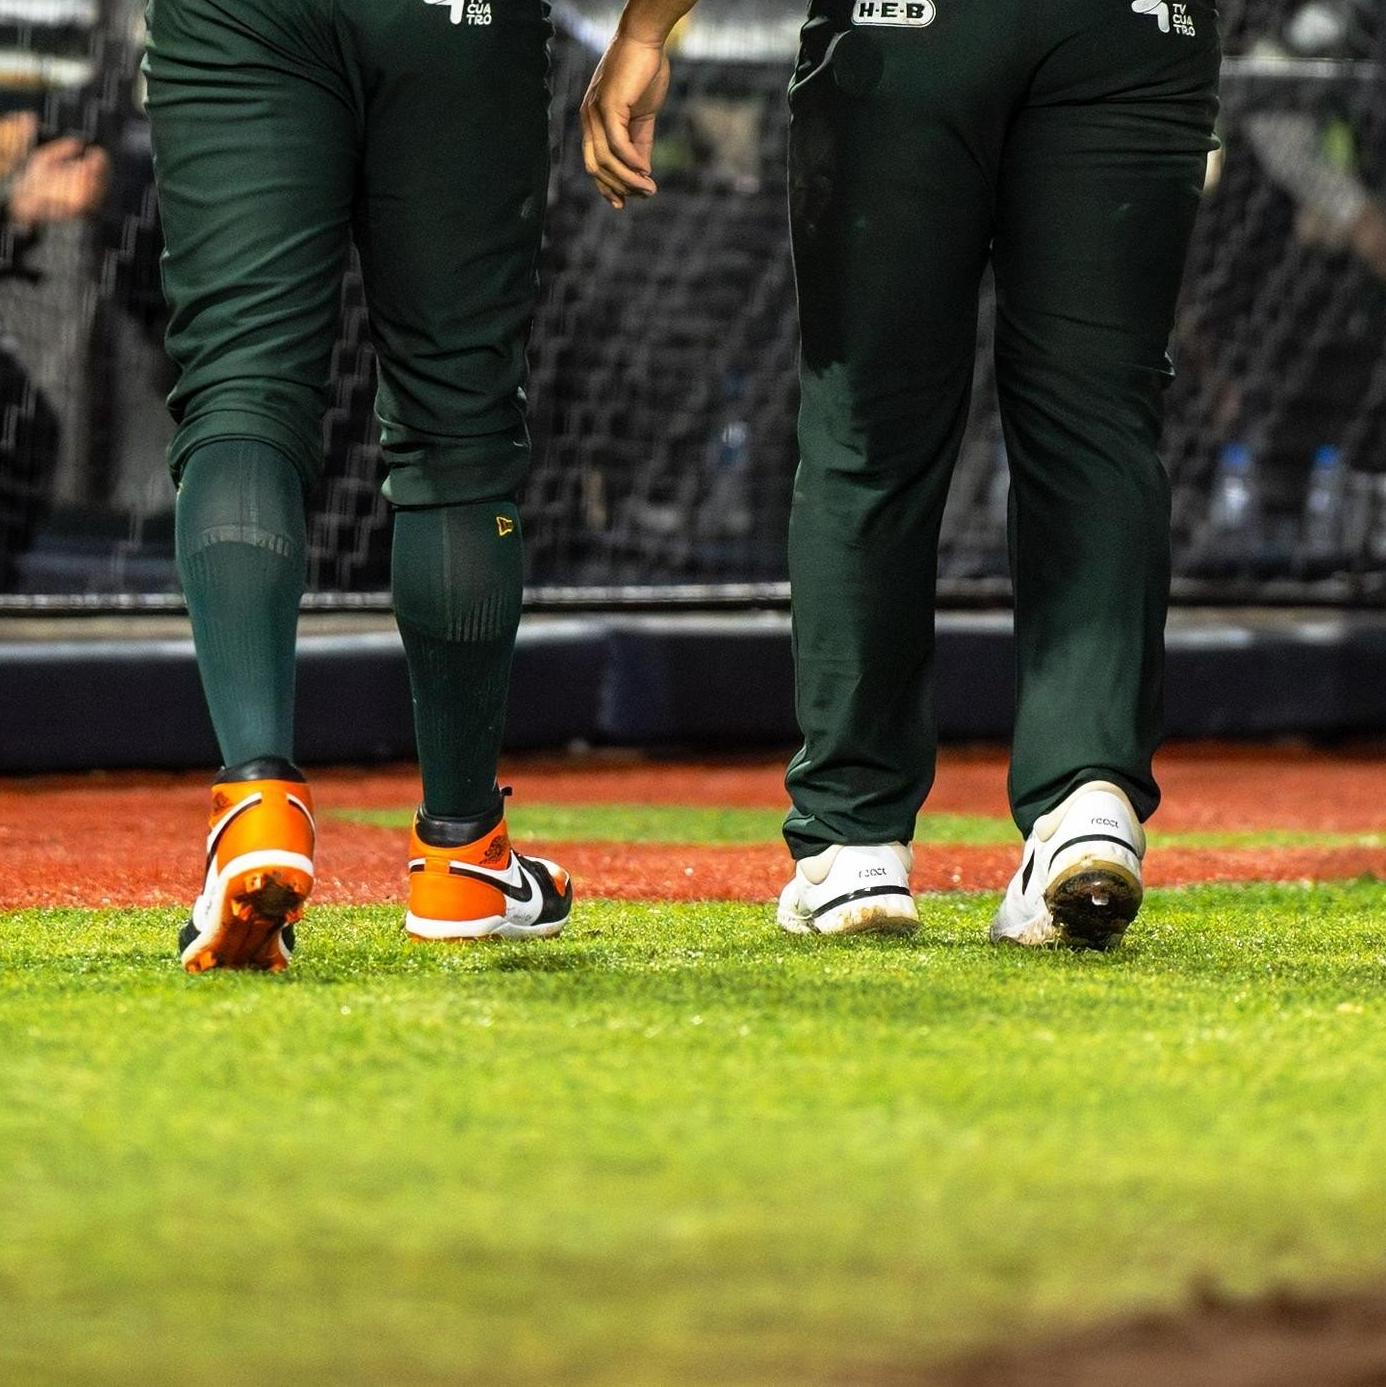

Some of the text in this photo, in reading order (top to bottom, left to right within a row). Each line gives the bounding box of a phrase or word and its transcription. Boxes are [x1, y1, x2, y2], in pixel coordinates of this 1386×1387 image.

[467, 3, 491, 14] CUA
[1173, 4, 1186, 14] TV
[466, 14, 492, 25] TRO
[1173, 14, 1193, 25] CUA
